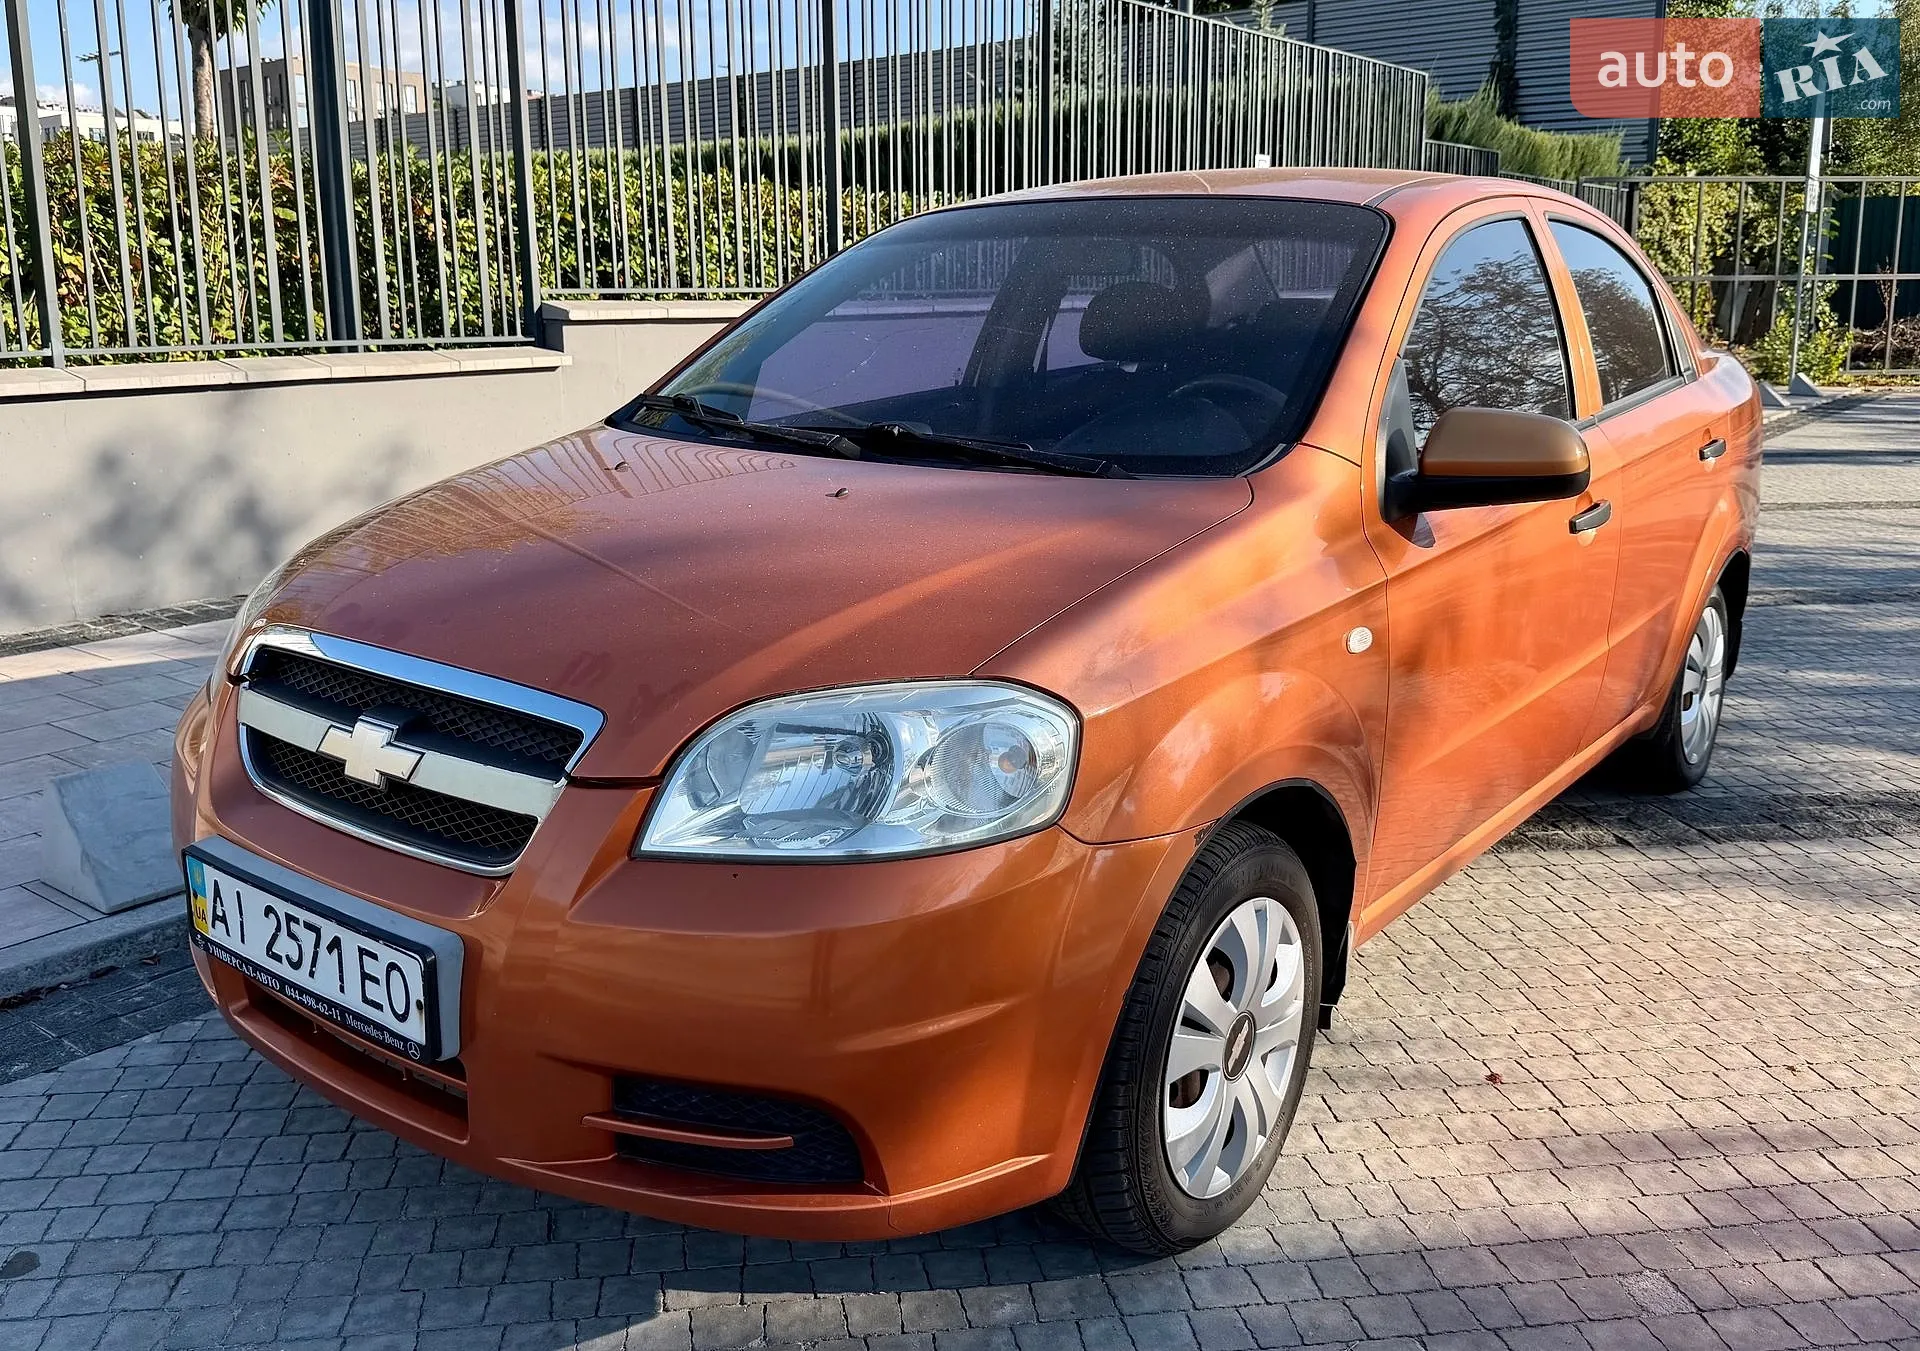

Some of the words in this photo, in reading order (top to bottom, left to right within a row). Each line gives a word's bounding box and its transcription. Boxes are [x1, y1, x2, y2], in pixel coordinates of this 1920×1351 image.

[195, 908, 208, 925] UA
[211, 879, 245, 945] AI
[264, 904, 345, 995] 2571
[345, 1013, 405, 1051] Mercedes-Benz
